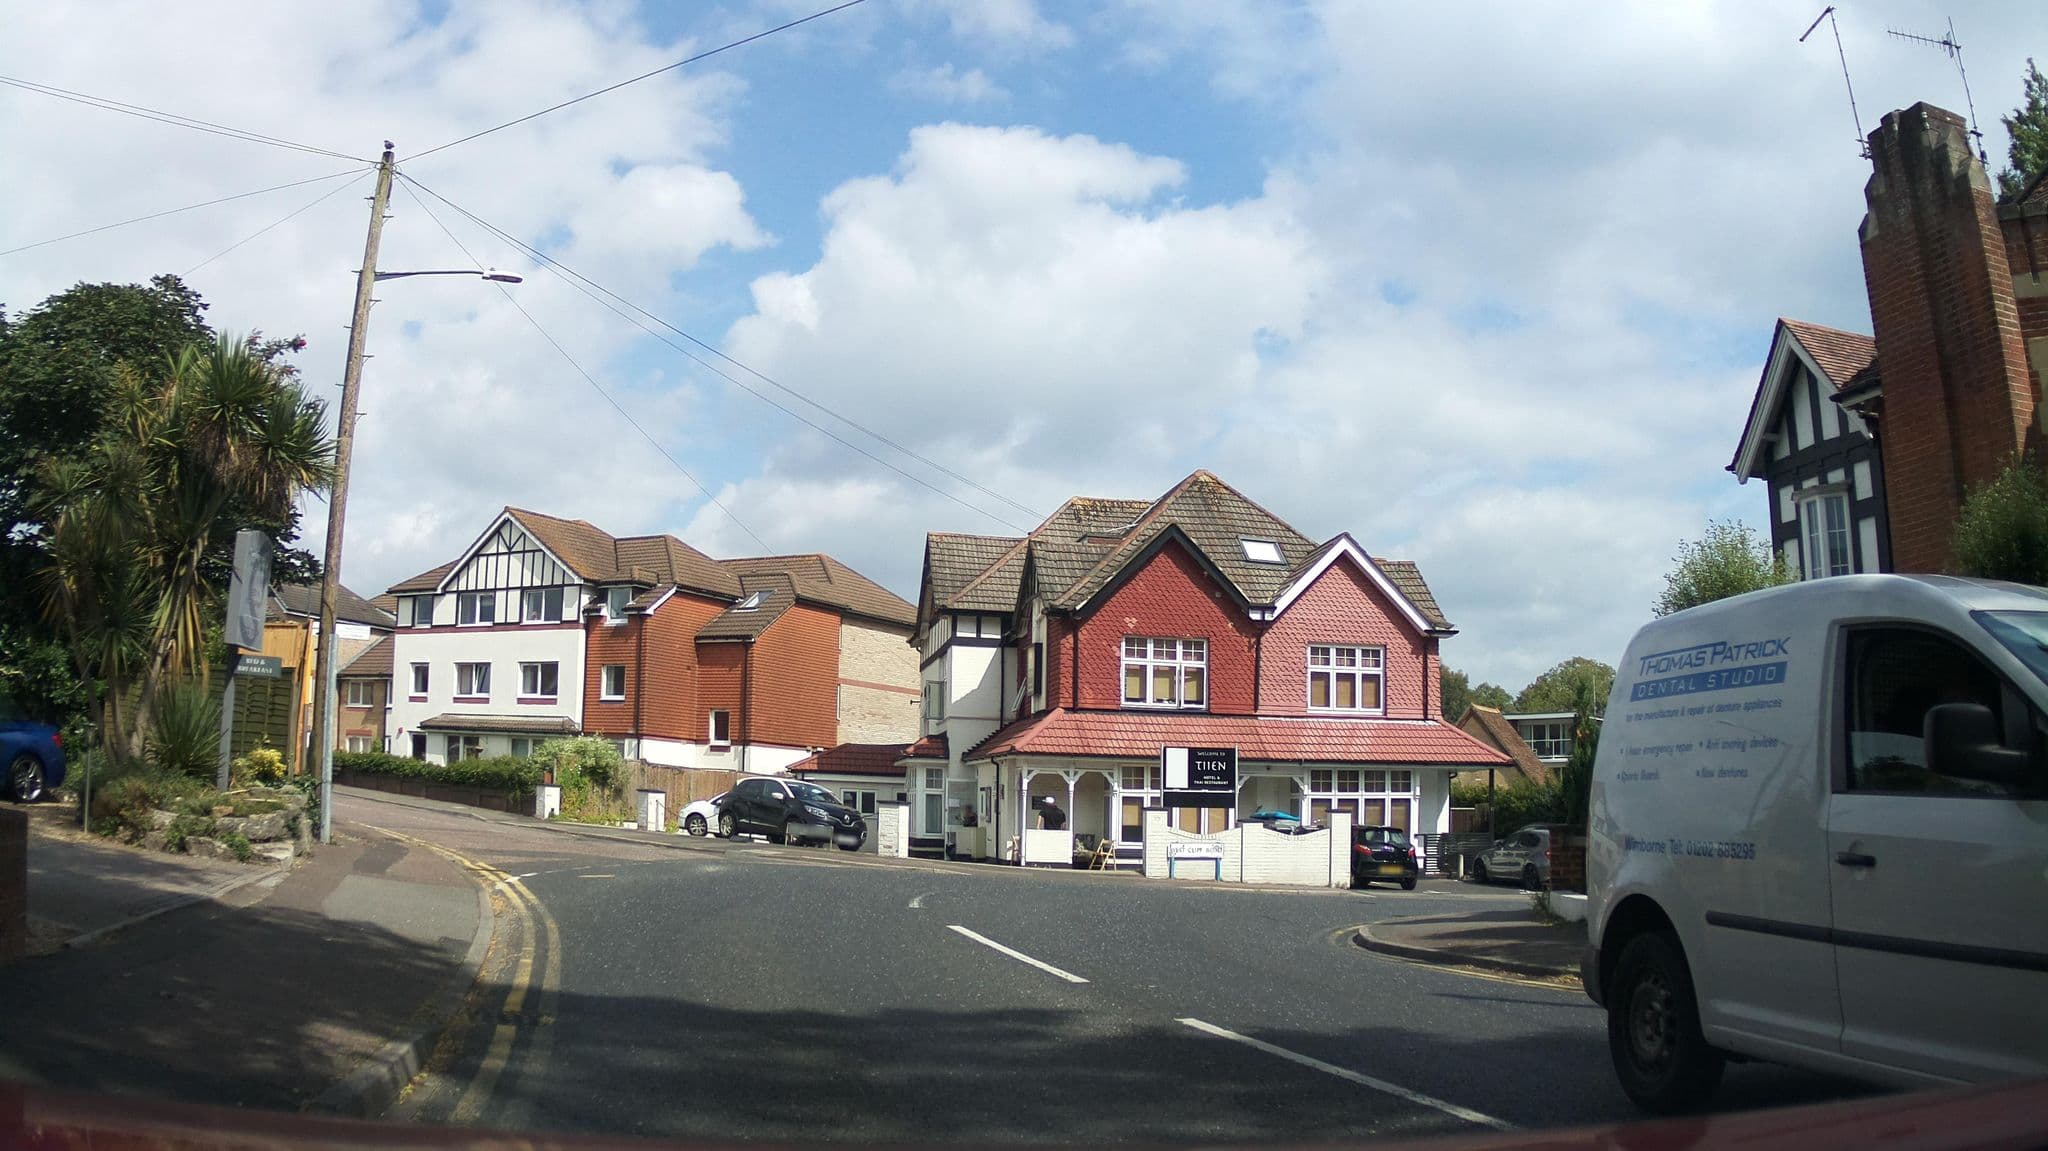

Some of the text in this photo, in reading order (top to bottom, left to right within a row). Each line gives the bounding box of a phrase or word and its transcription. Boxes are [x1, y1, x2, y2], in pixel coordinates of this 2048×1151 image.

[1639, 637, 1791, 676] THOMAS PATRICK
[1638, 667, 1777, 698] DENTAL STUDIO
[1644, 708, 1680, 720] manufacture
[1687, 705, 1705, 717] repair
[1707, 704, 1714, 714] of
[1743, 698, 1783, 712] appliances
[1643, 743, 1674, 757] emergency
[1750, 736, 1778, 748] devices
[1195, 760, 1226, 771] TIIEN
[1624, 835, 1665, 854] Wimborne
[1686, 840, 1714, 857] 01202
